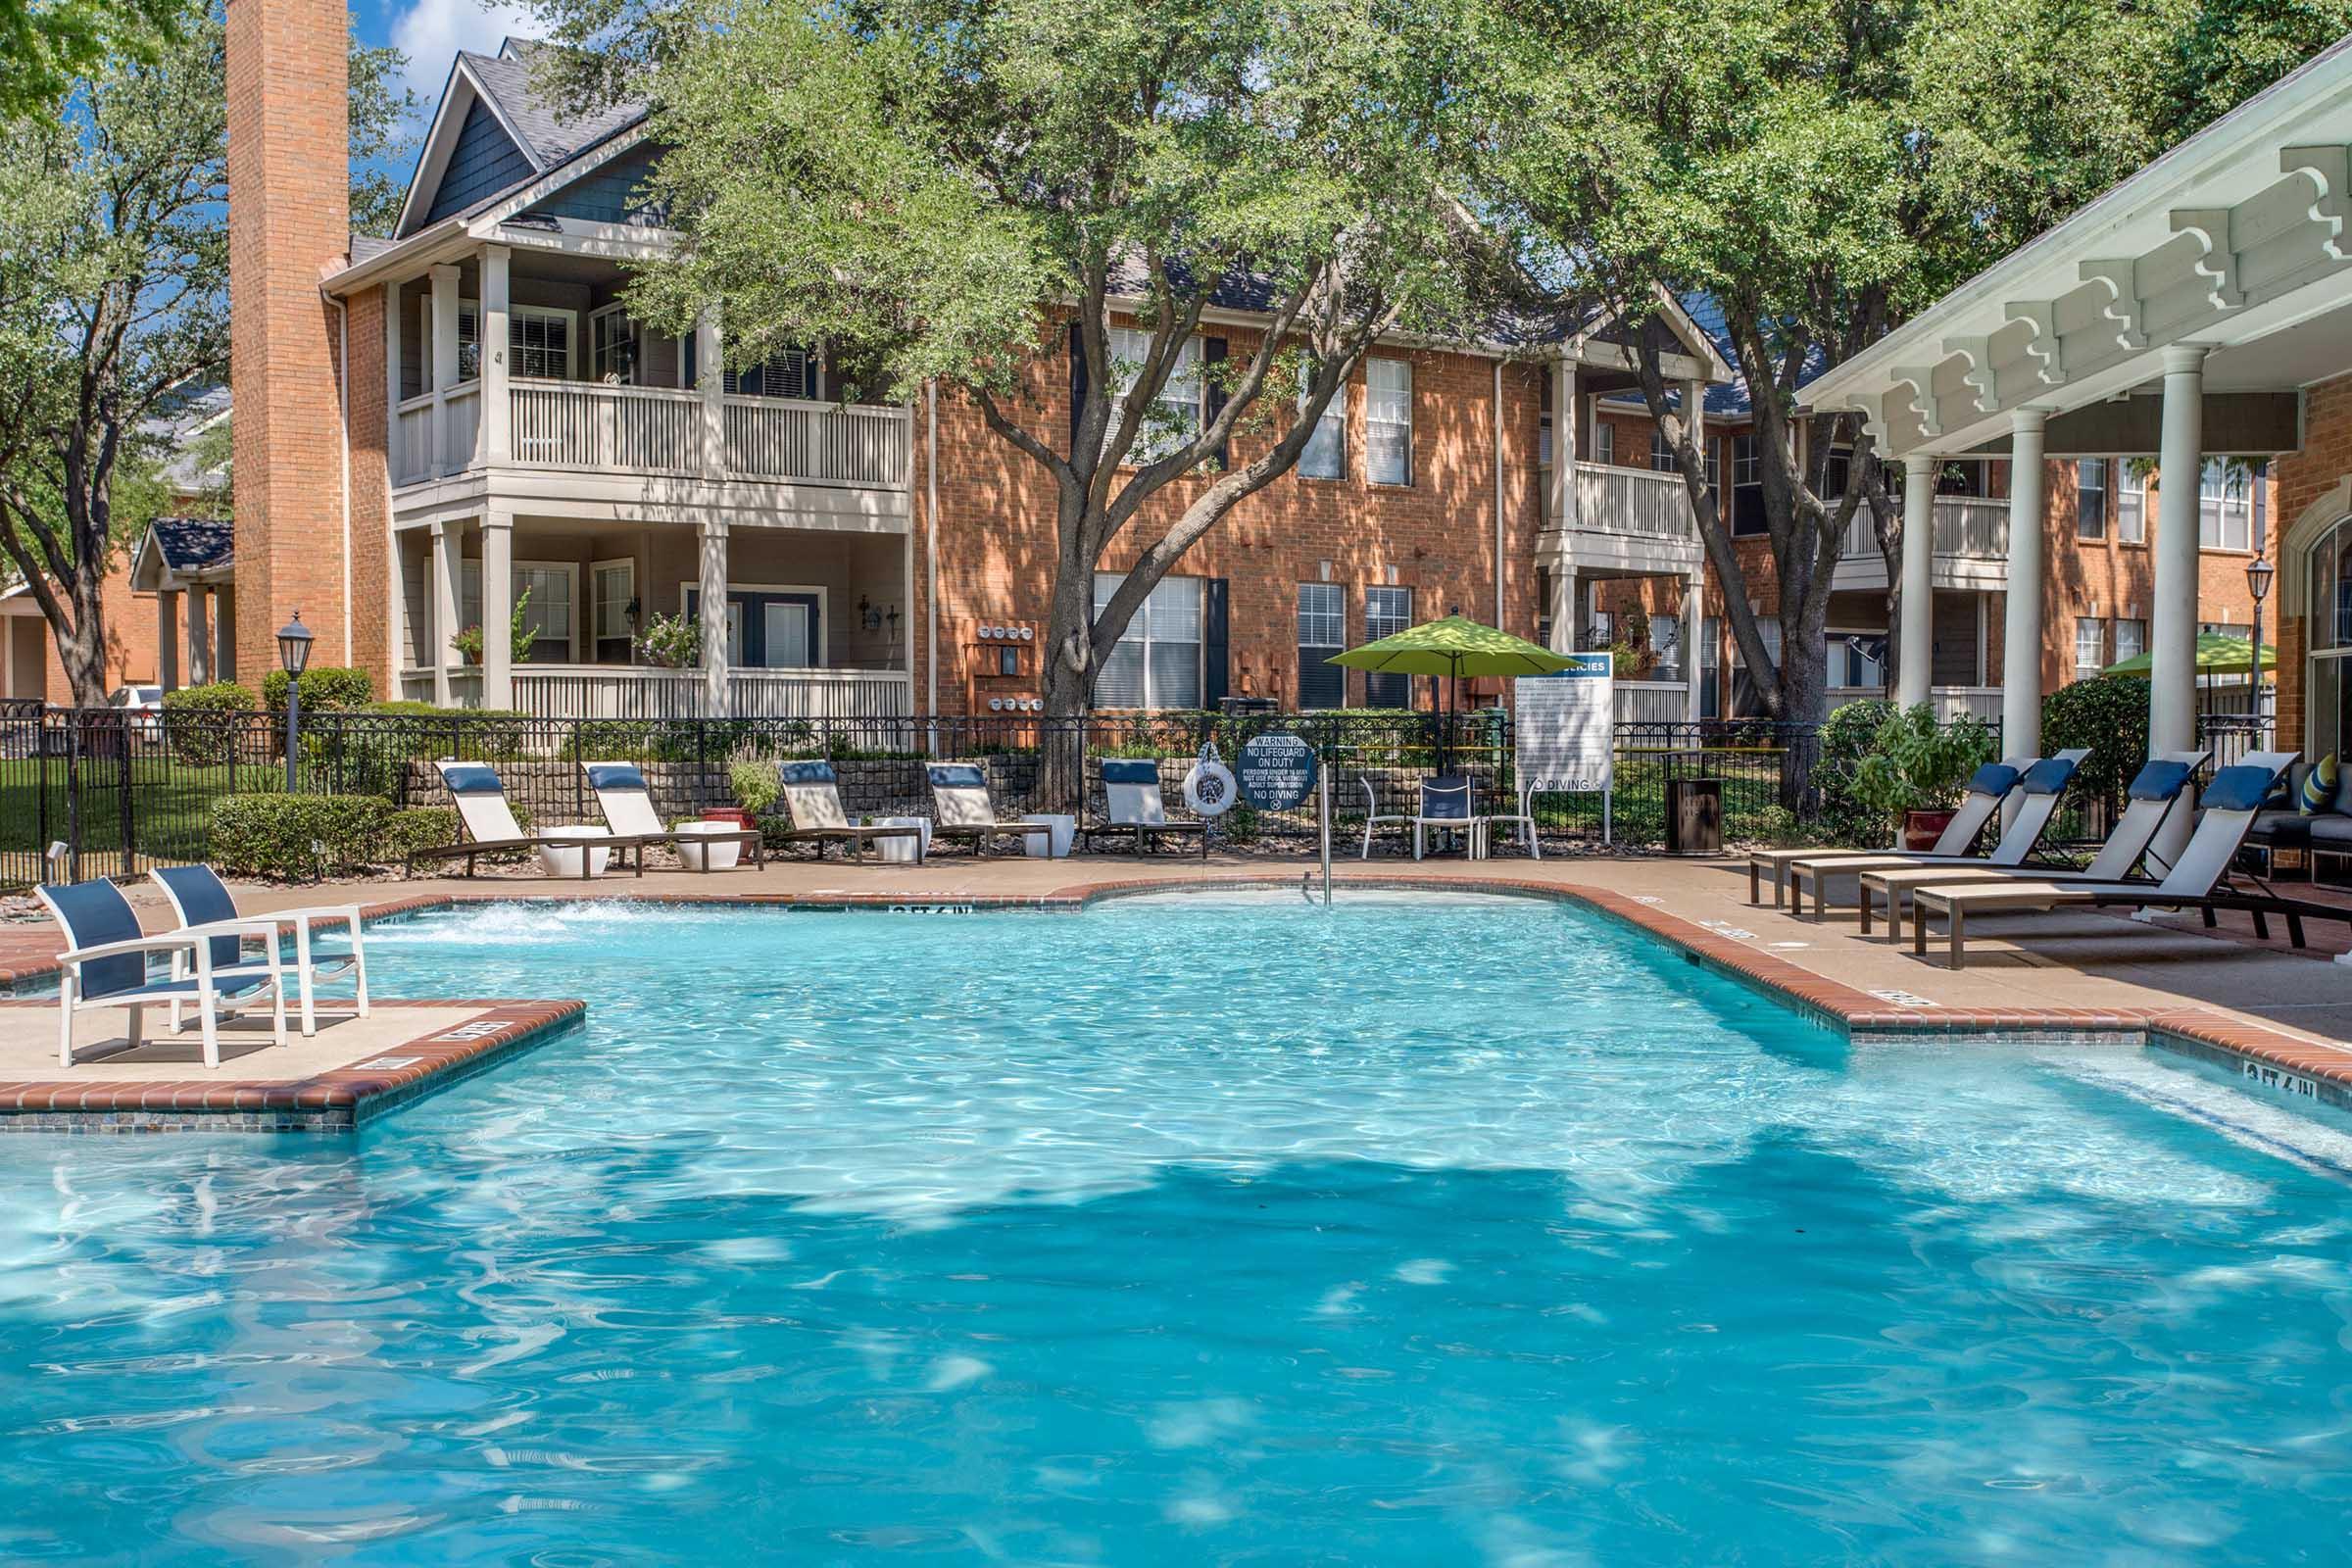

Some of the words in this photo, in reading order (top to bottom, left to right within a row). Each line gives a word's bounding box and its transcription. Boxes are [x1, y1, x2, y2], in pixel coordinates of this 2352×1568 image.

[1256, 737, 1298, 746] WARNING
[1248, 748, 1261, 757] NO
[1261, 748, 1305, 757] LIFEGUARD
[1258, 759, 1271, 767] ON
[1272, 759, 1295, 767] DUTY
[1547, 779, 1590, 790] DIVING
